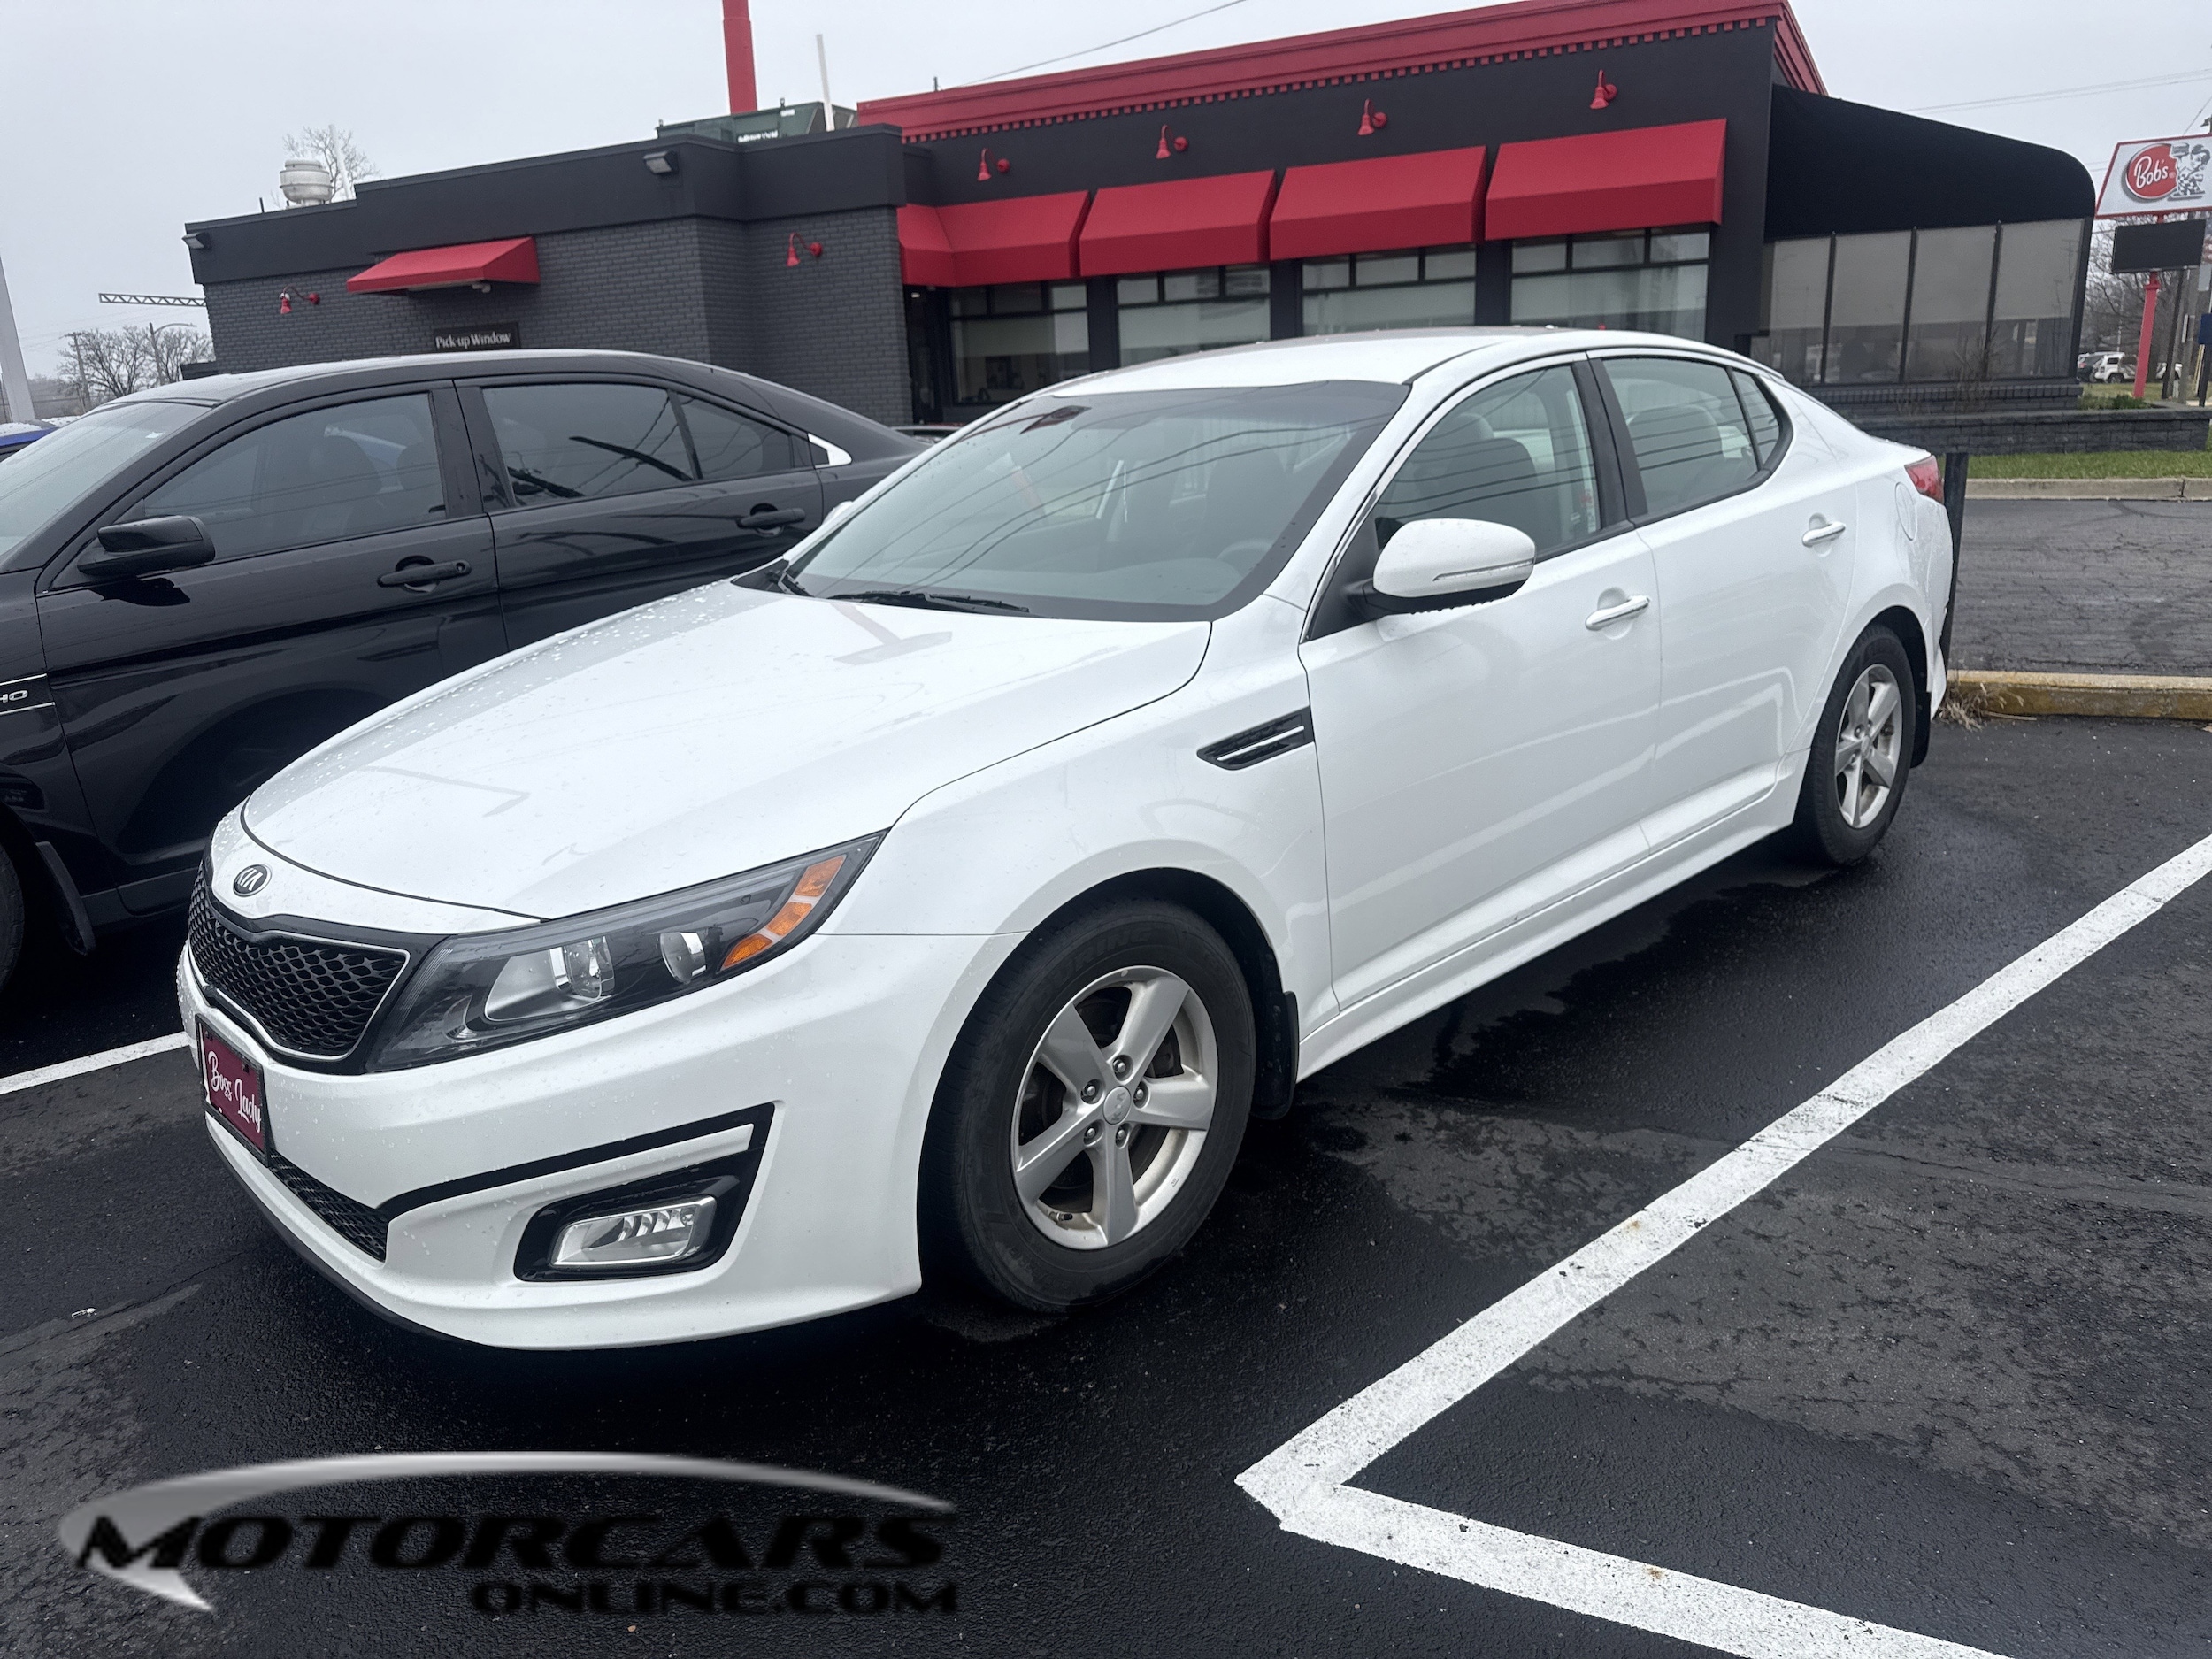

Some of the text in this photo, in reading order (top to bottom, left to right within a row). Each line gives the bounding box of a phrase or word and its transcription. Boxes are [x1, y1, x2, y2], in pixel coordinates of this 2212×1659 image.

[2133, 155, 2170, 189] Bob's
[471, 331, 511, 346] Window
[234, 867, 264, 892] KIA
[208, 1050, 262, 1133] Boss Lady
